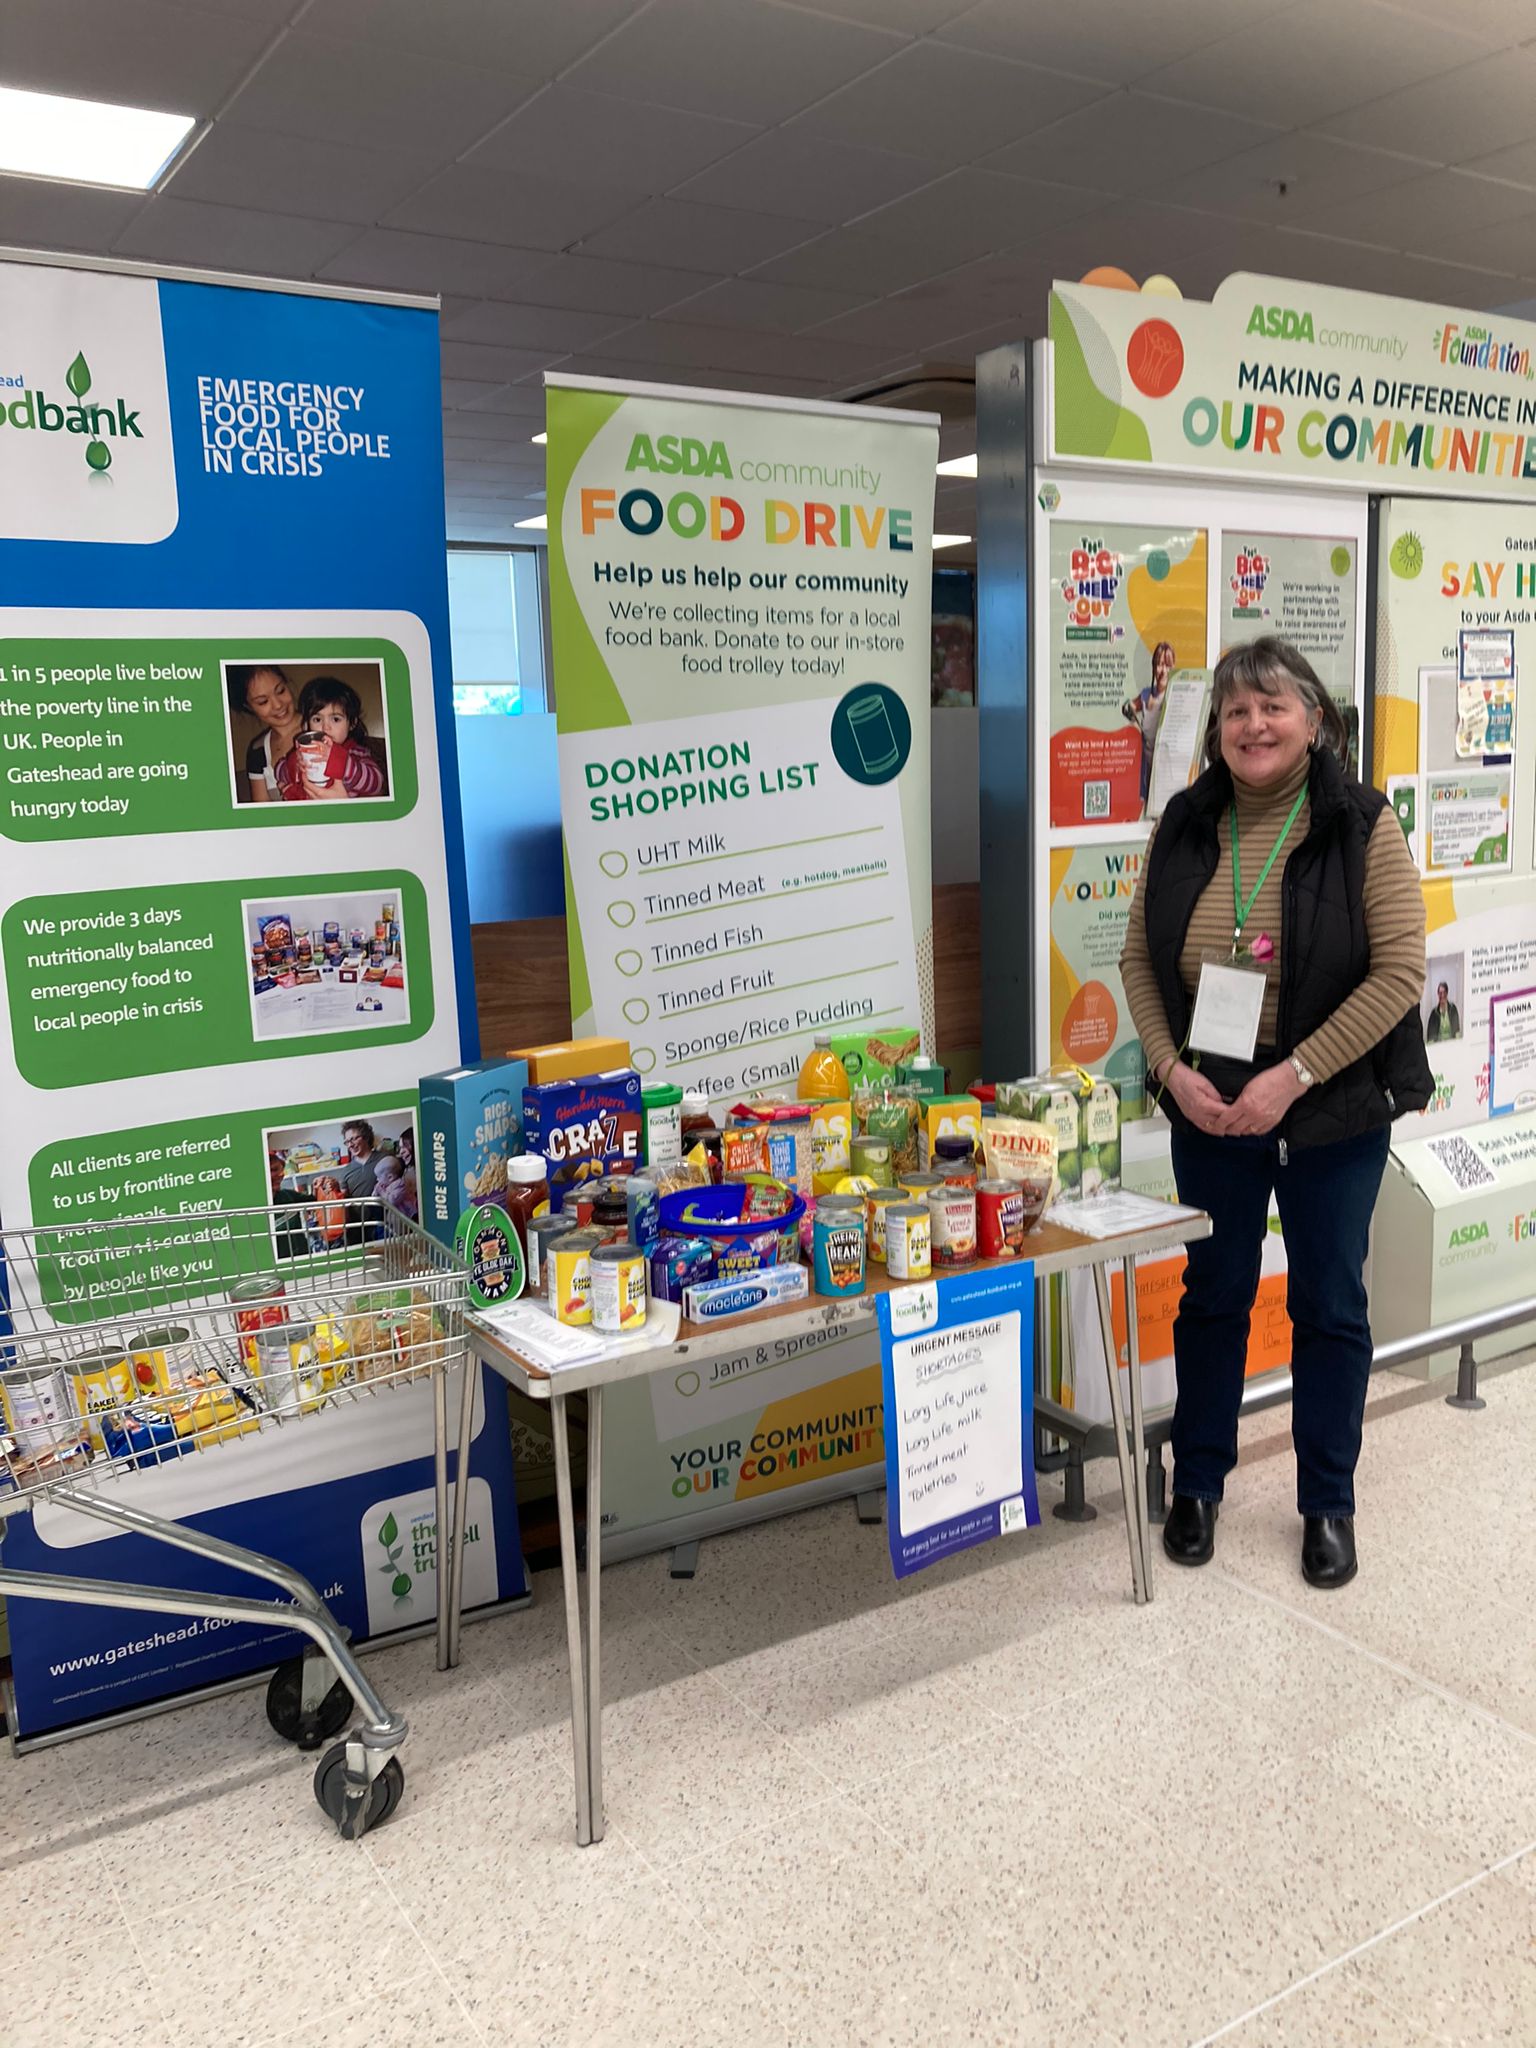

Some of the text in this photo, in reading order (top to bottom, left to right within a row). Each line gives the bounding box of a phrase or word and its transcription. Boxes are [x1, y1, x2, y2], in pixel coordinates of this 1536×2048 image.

[1246, 304, 1408, 361] ASDA community
[1465, 326, 1487, 340] ASDA
[1440, 323, 1530, 376] Foundation
[197, 376, 364, 411] EMERGENCY
[1239, 361, 1536, 425] MAKING A DIFFERENCE IN
[200, 401, 341, 431] FOOD FOR
[1182, 396, 1284, 456] OUR
[202, 426, 390, 458] LOCAL PEOPLE
[204, 449, 322, 477] IN CRISIS
[625, 433, 881, 496] ASDA community
[581, 488, 914, 553] FOOD DRIVE
[1505, 537, 1536, 551] Gates
[594, 561, 909, 599] Help us help our community
[1079, 577, 1118, 599] HELP
[1441, 561, 1505, 598] SAY
[608, 600, 900, 627] We're collecting items for a local
[1076, 599, 1111, 618] OUT
[1461, 609, 1531, 626] to your Asda
[605, 628, 905, 652] food bank. Donate to our in-store
[12, 665, 30, 682] in
[36, 668, 46, 683] 5
[51, 664, 112, 685] people
[116, 664, 145, 681] live
[150, 663, 203, 681] below
[682, 655, 846, 678] food trolley today!
[0, 696, 192, 719] the poverty line in the
[3, 730, 123, 751] UK. People in
[7, 761, 188, 783] Gateshead are going
[585, 741, 751, 790] DONATION
[11, 796, 129, 819] hungry today
[590, 763, 820, 823] SHOPPING LIST
[637, 833, 726, 866] UHT Milk
[644, 884, 712, 915] Tinned
[718, 875, 766, 898] Meat
[804, 869, 841, 885] hotdog,
[23, 907, 182, 936] We provide 3 days
[1099, 911, 1113, 921] Did
[28, 934, 213, 968] nutritionally balanced
[651, 925, 764, 964] Tinned Fish
[31, 969, 192, 999] emergency food to
[658, 970, 776, 1012] Tinned Fruit
[34, 997, 203, 1031] local people in crisis
[1506, 1002, 1532, 1016] DONNA
[665, 997, 874, 1061] Sponge/Rice Pudding
[484, 1101, 508, 1122] RICE
[475, 1114, 519, 1146] SNAPS
[545, 1110, 638, 1162] CRAZE
[50, 1134, 231, 1179] All clients are referred
[53, 1166, 232, 1209] to us by frontline care
[433, 1132, 449, 1220] RICE SNAPS
[831, 1232, 859, 1245] HEINZ
[1449, 1220, 1489, 1248] ASDA
[499, 1255, 513, 1269] OAK
[717, 1255, 761, 1269] SWEET
[1439, 1240, 1498, 1267] community
[150, 1258, 213, 1282] like you
[484, 1281, 511, 1299] HAM
[704, 1289, 763, 1314] macleans
[896, 1301, 933, 1318] foodbank
[710, 1325, 848, 1381] Jam & Spreads
[910, 1321, 1001, 1357] URGENT MESSAGE
[916, 1347, 982, 1379] SHORTAGES
[904, 1404, 931, 1424] Long
[935, 1392, 955, 1409] Life
[906, 1407, 983, 1453] Long Life milk
[671, 1440, 742, 1473] YOUR
[906, 1442, 969, 1480] Tinned meat
[671, 1467, 729, 1498] OUR
[909, 1473, 957, 1502] Toiletries
